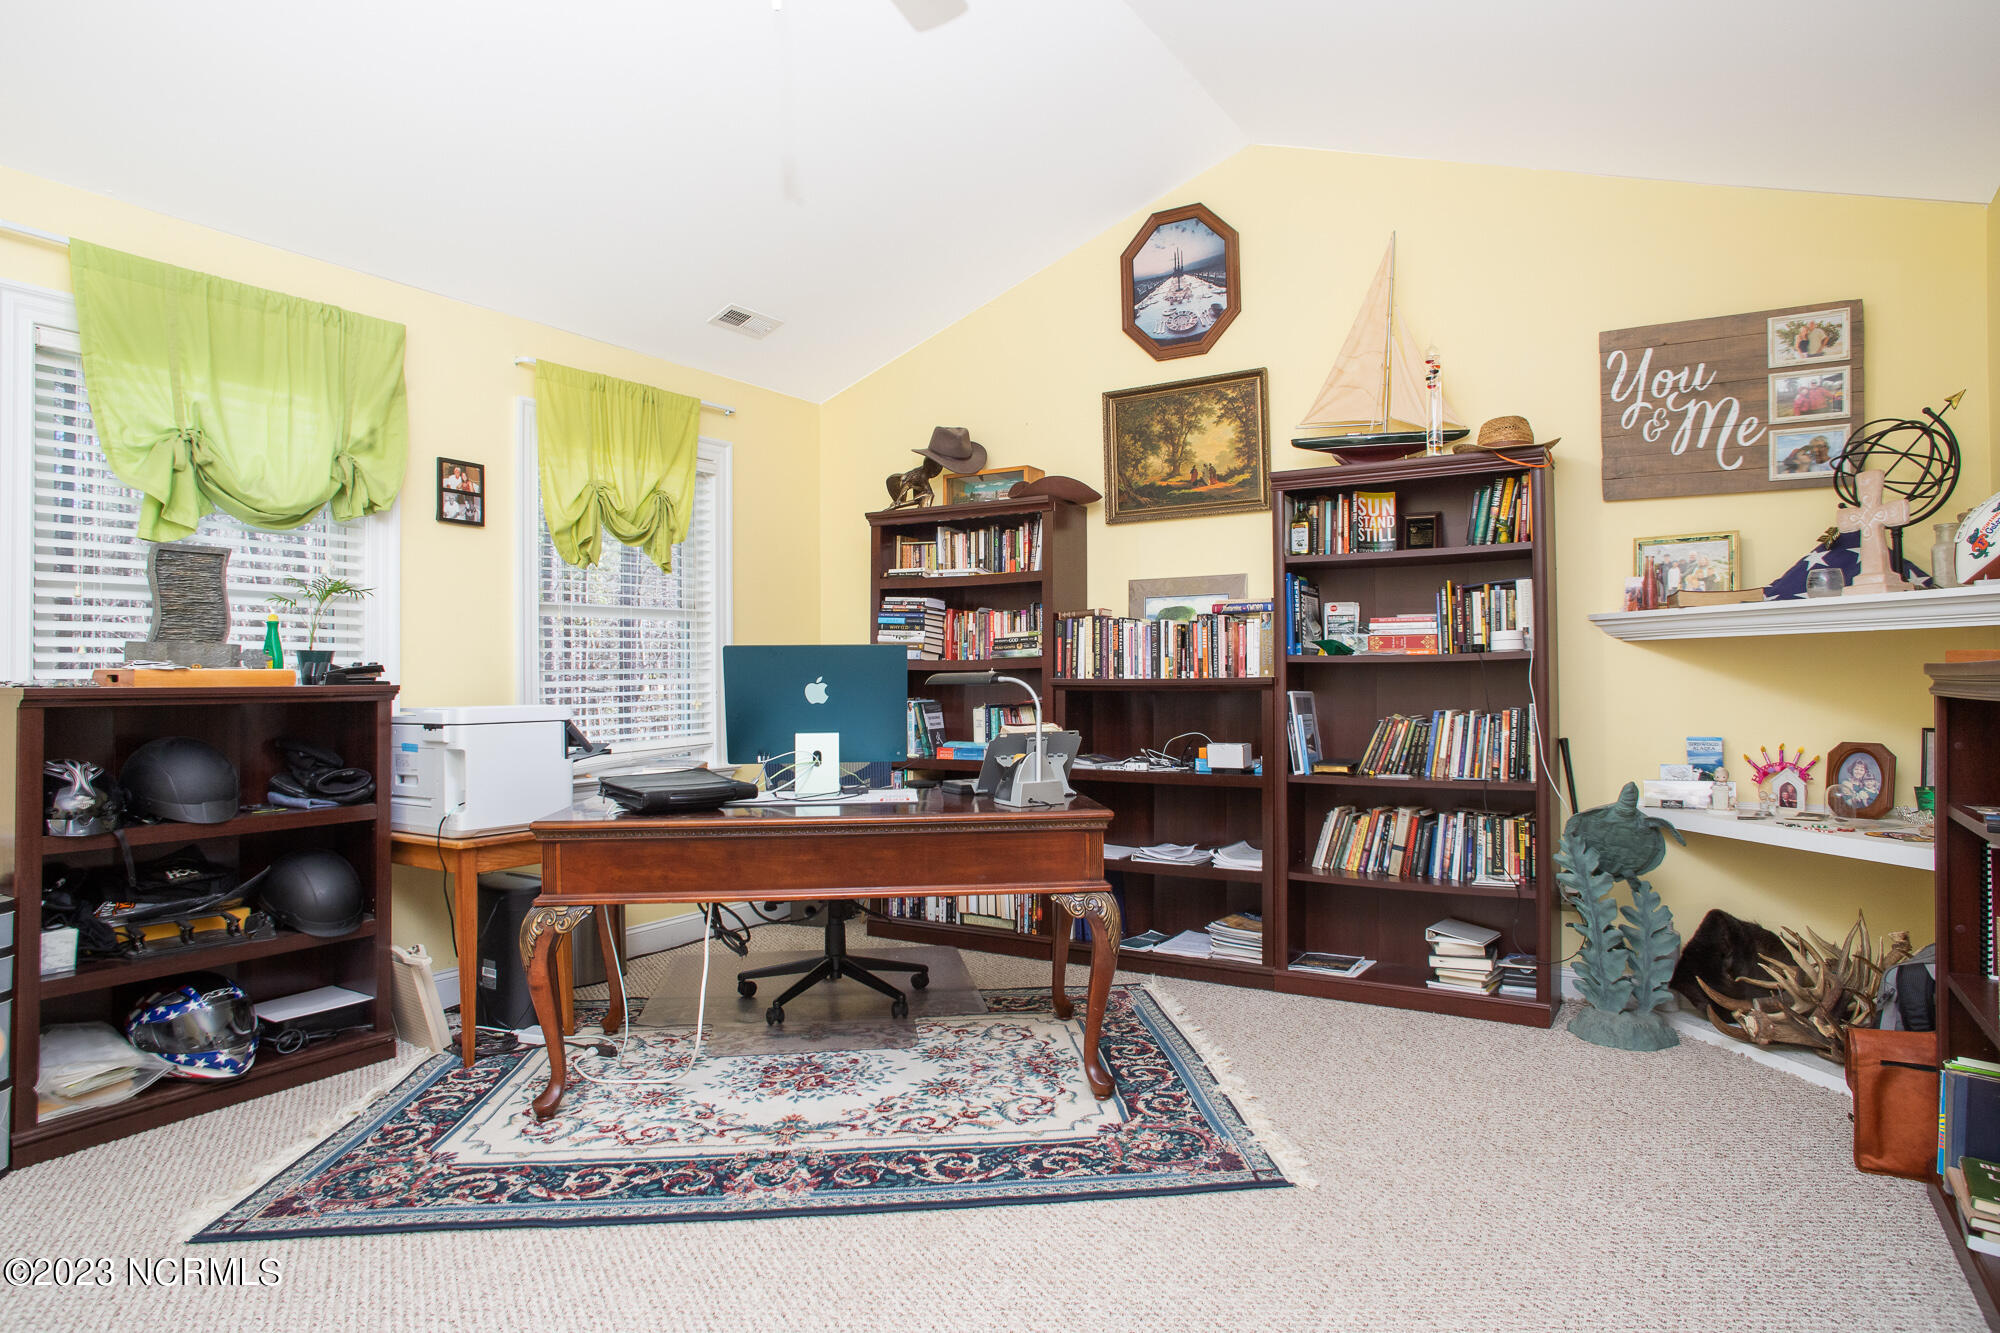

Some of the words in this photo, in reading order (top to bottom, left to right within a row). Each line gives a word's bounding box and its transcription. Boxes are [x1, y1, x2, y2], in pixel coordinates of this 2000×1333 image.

[1606, 348, 1717, 430] You
[1643, 408, 1669, 443] &
[1667, 391, 1767, 471] Me
[1357, 497, 1395, 517] SUN
[1357, 516, 1395, 528] STAND
[1357, 528, 1396, 542] STILL
